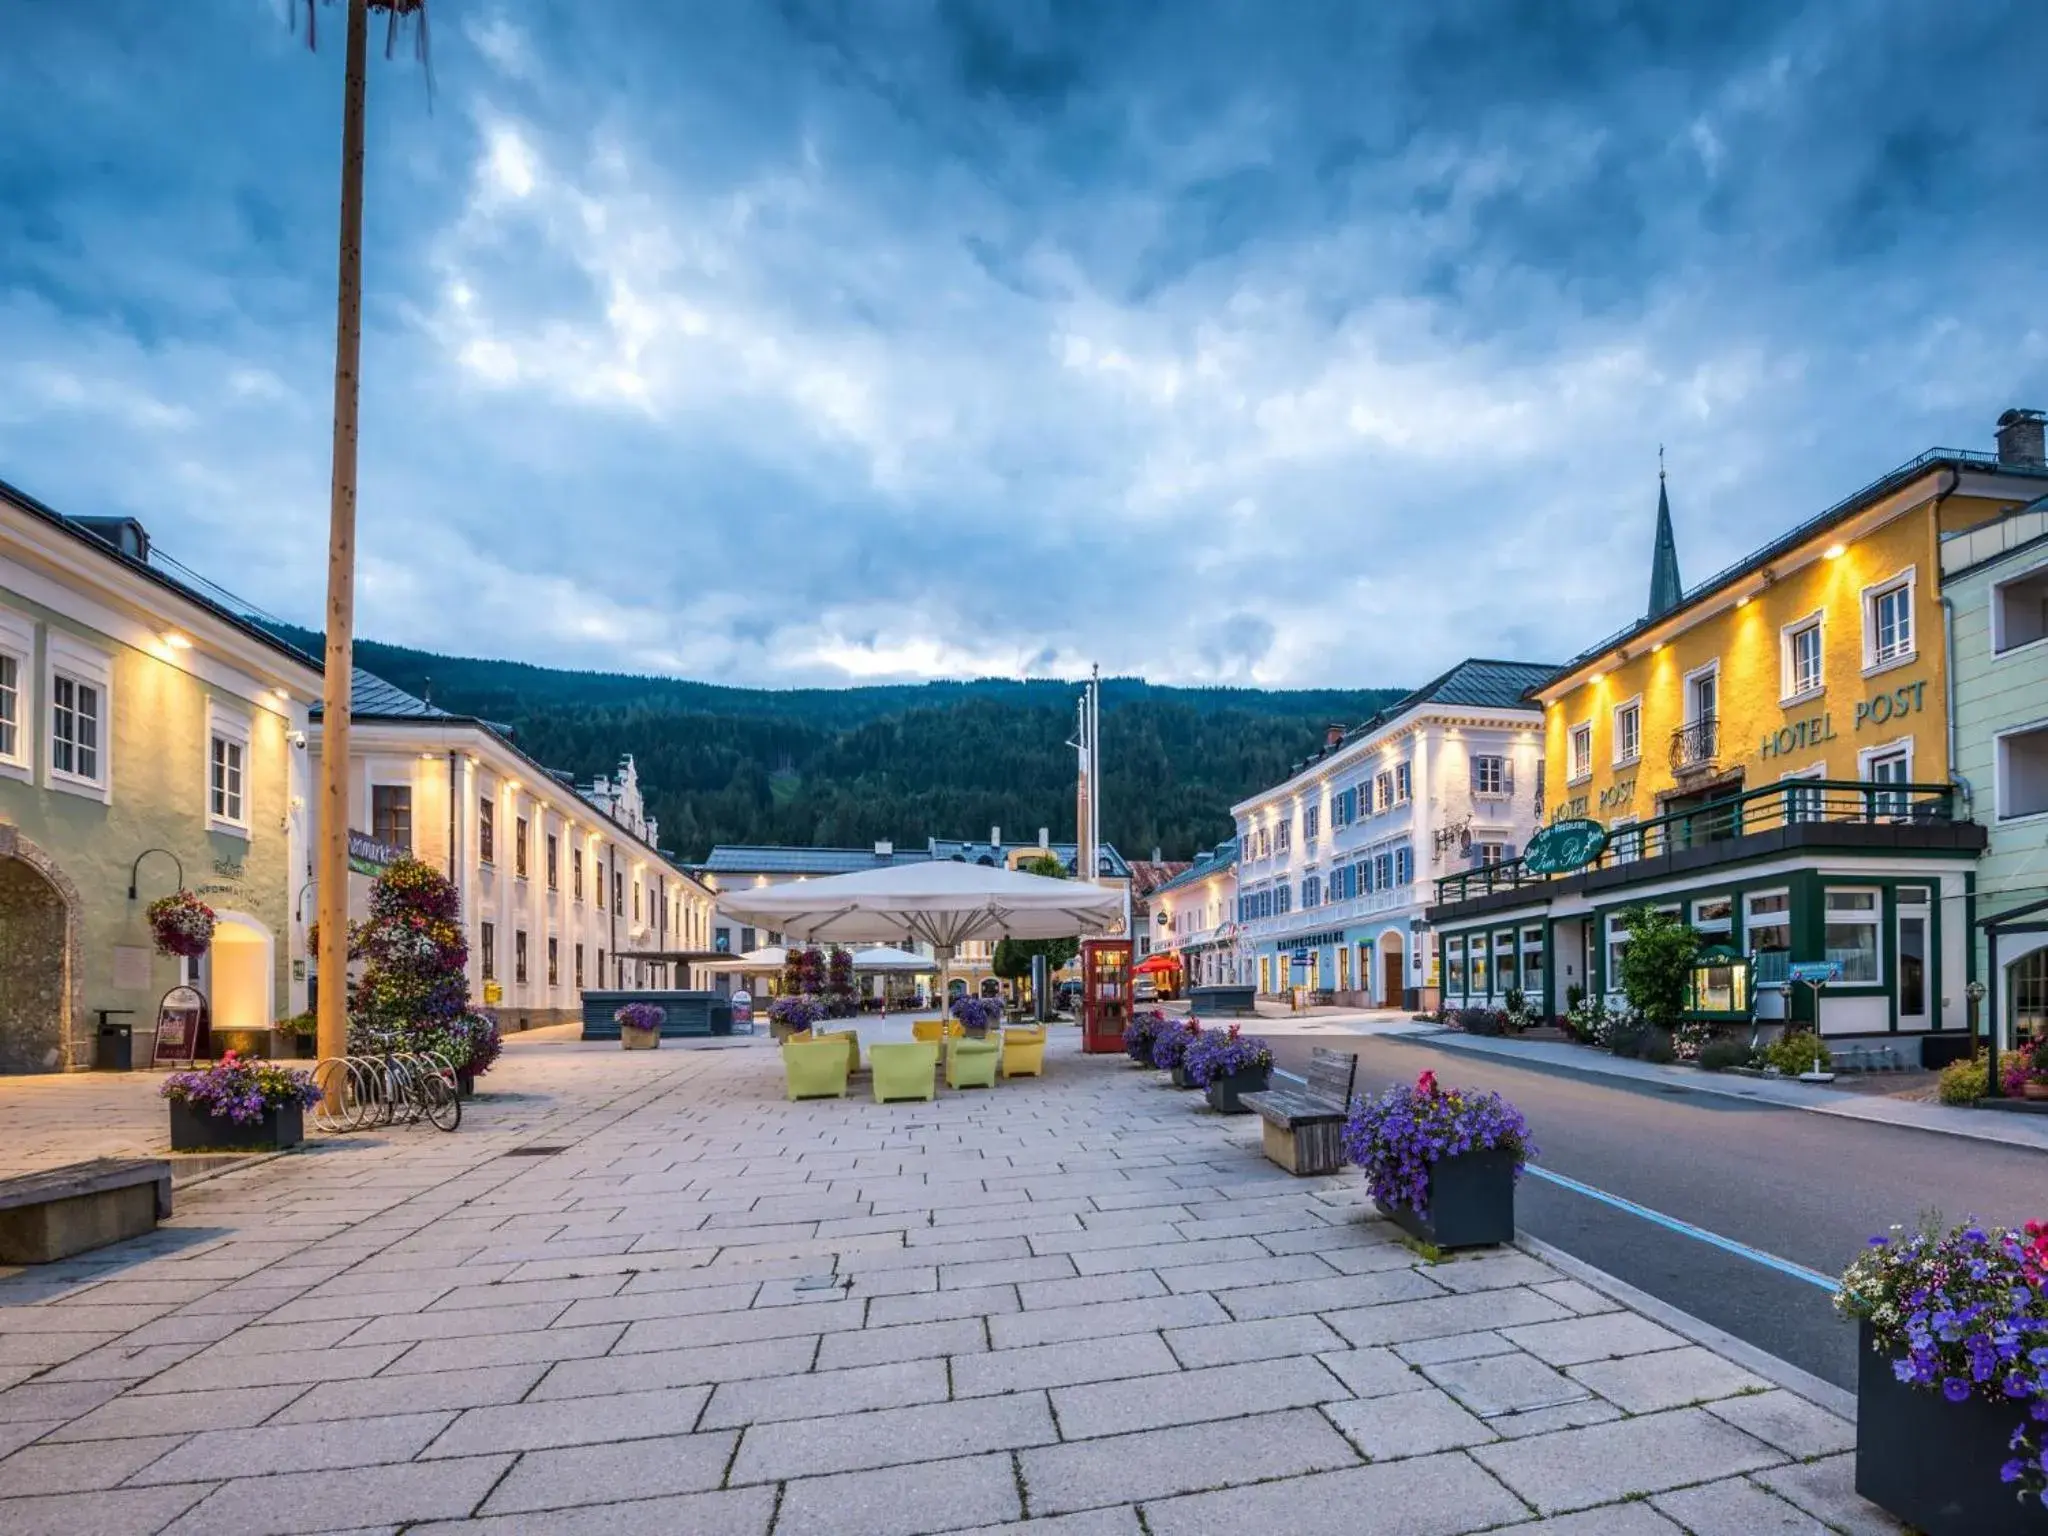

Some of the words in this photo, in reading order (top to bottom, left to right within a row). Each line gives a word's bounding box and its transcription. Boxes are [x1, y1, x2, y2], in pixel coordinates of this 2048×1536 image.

[1760, 712, 1838, 761] HOTEL
[1854, 679, 1927, 731] POST
[1551, 796, 1591, 822] HOTEL
[1600, 778, 1636, 810] POST
